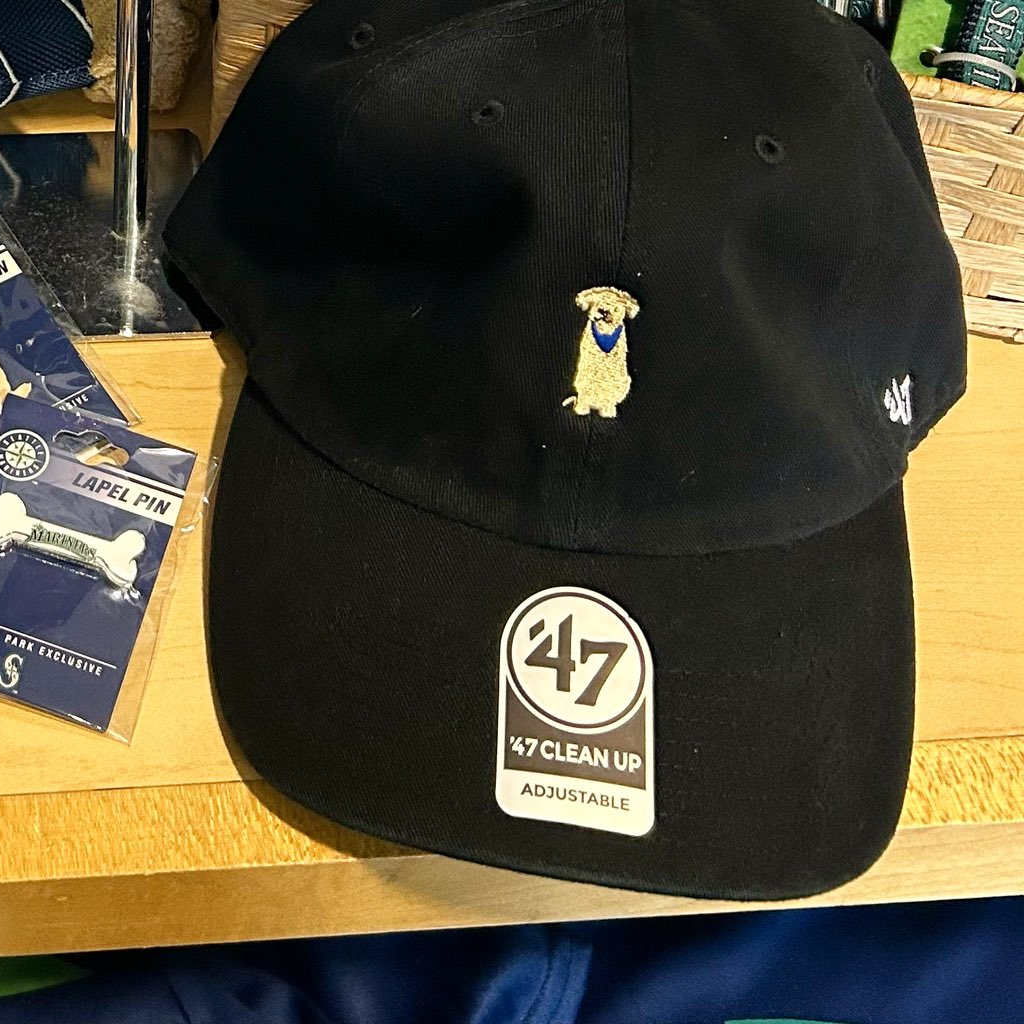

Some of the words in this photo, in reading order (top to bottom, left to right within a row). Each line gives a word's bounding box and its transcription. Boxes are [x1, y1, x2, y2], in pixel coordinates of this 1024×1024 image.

[971, 0, 1020, 90] SEAT
[72, 471, 128, 503] LAPEL
[133, 491, 172, 516] PIN
[4, 633, 35, 653] PARK
[38, 646, 104, 677] EXCLUSIVE
[539, 739, 609, 769] CLEAN
[613, 752, 643, 774] UP
[520, 782, 631, 812] ADJUSTABLE
